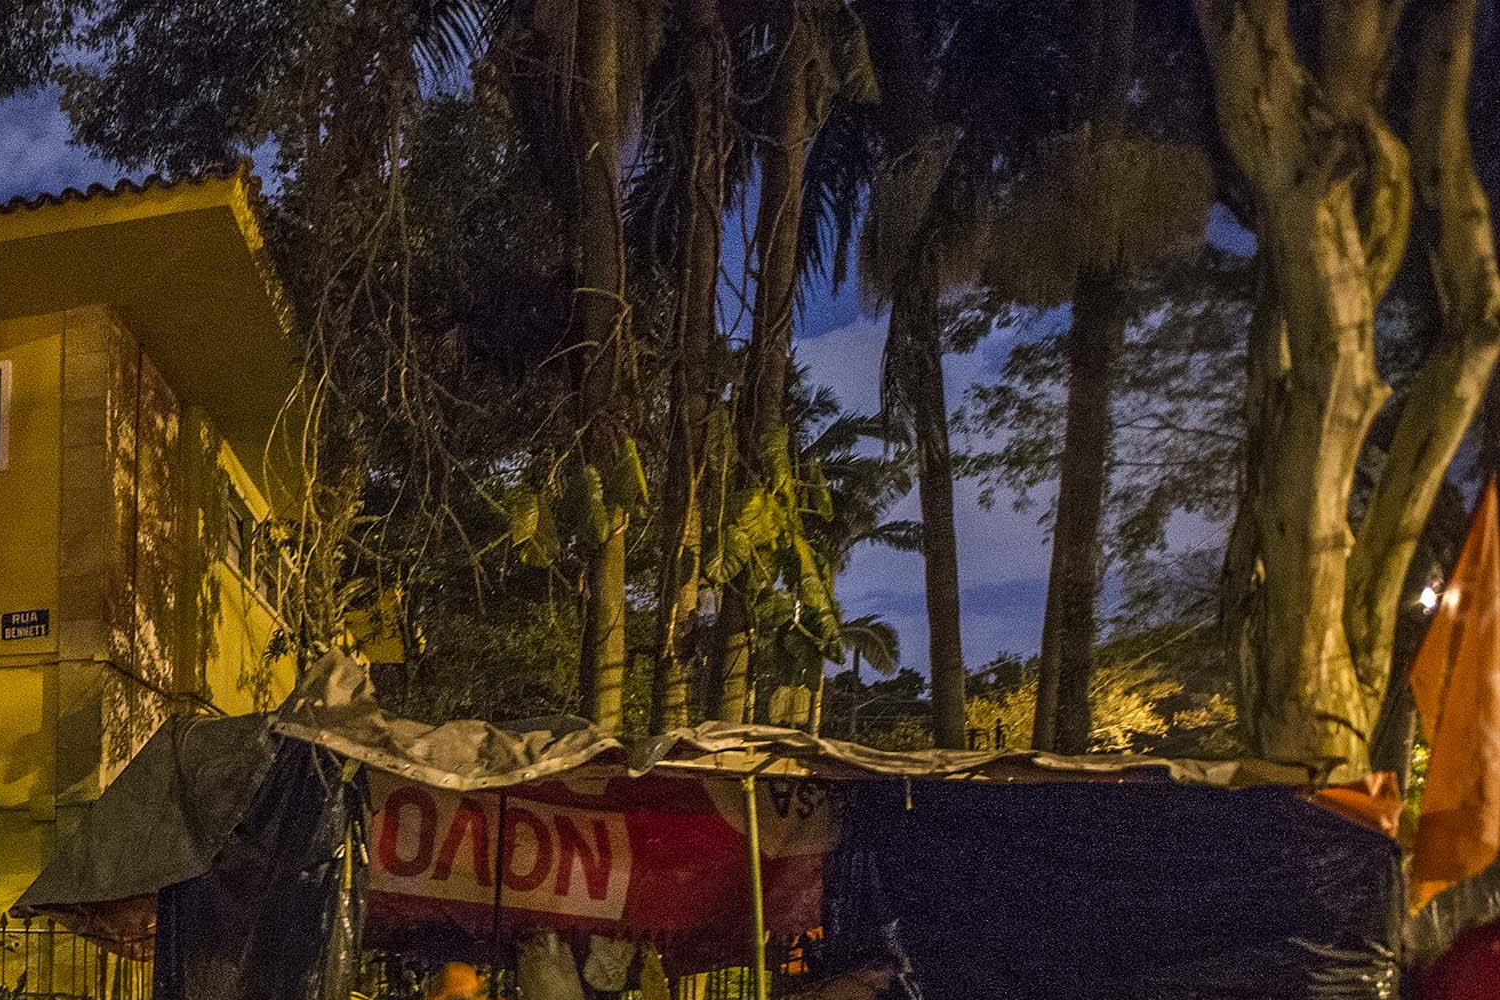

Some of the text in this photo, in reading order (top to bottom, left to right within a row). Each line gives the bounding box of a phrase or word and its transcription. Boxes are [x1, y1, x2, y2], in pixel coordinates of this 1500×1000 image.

[12, 612, 38, 624] RUA
[5, 624, 46, 639] BENNETT
[379, 785, 613, 900] NOVO
